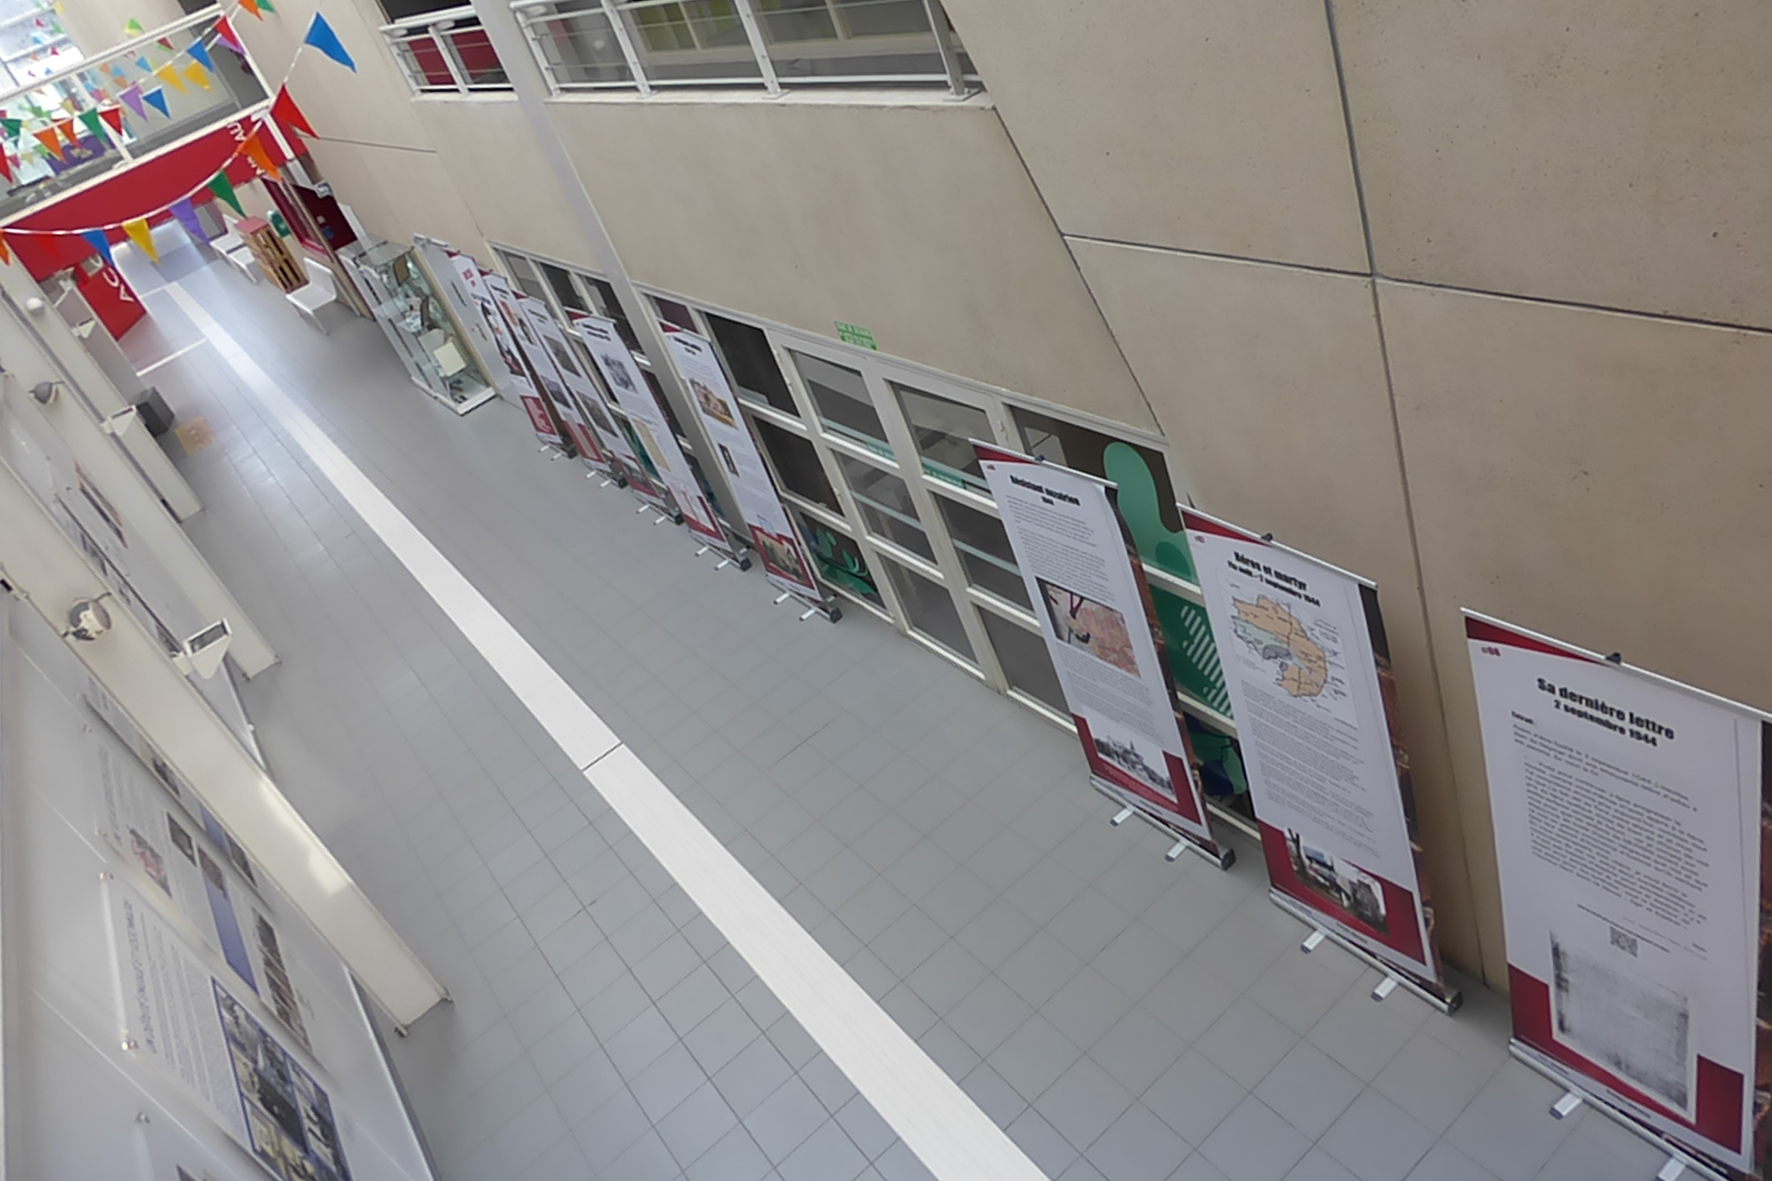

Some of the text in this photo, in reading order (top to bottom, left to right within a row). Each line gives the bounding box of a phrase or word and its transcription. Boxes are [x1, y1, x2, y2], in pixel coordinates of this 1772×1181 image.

[1536, 677, 1675, 740] Sa dernière lettre
[1553, 699, 1659, 747] 2 septembre 1944
